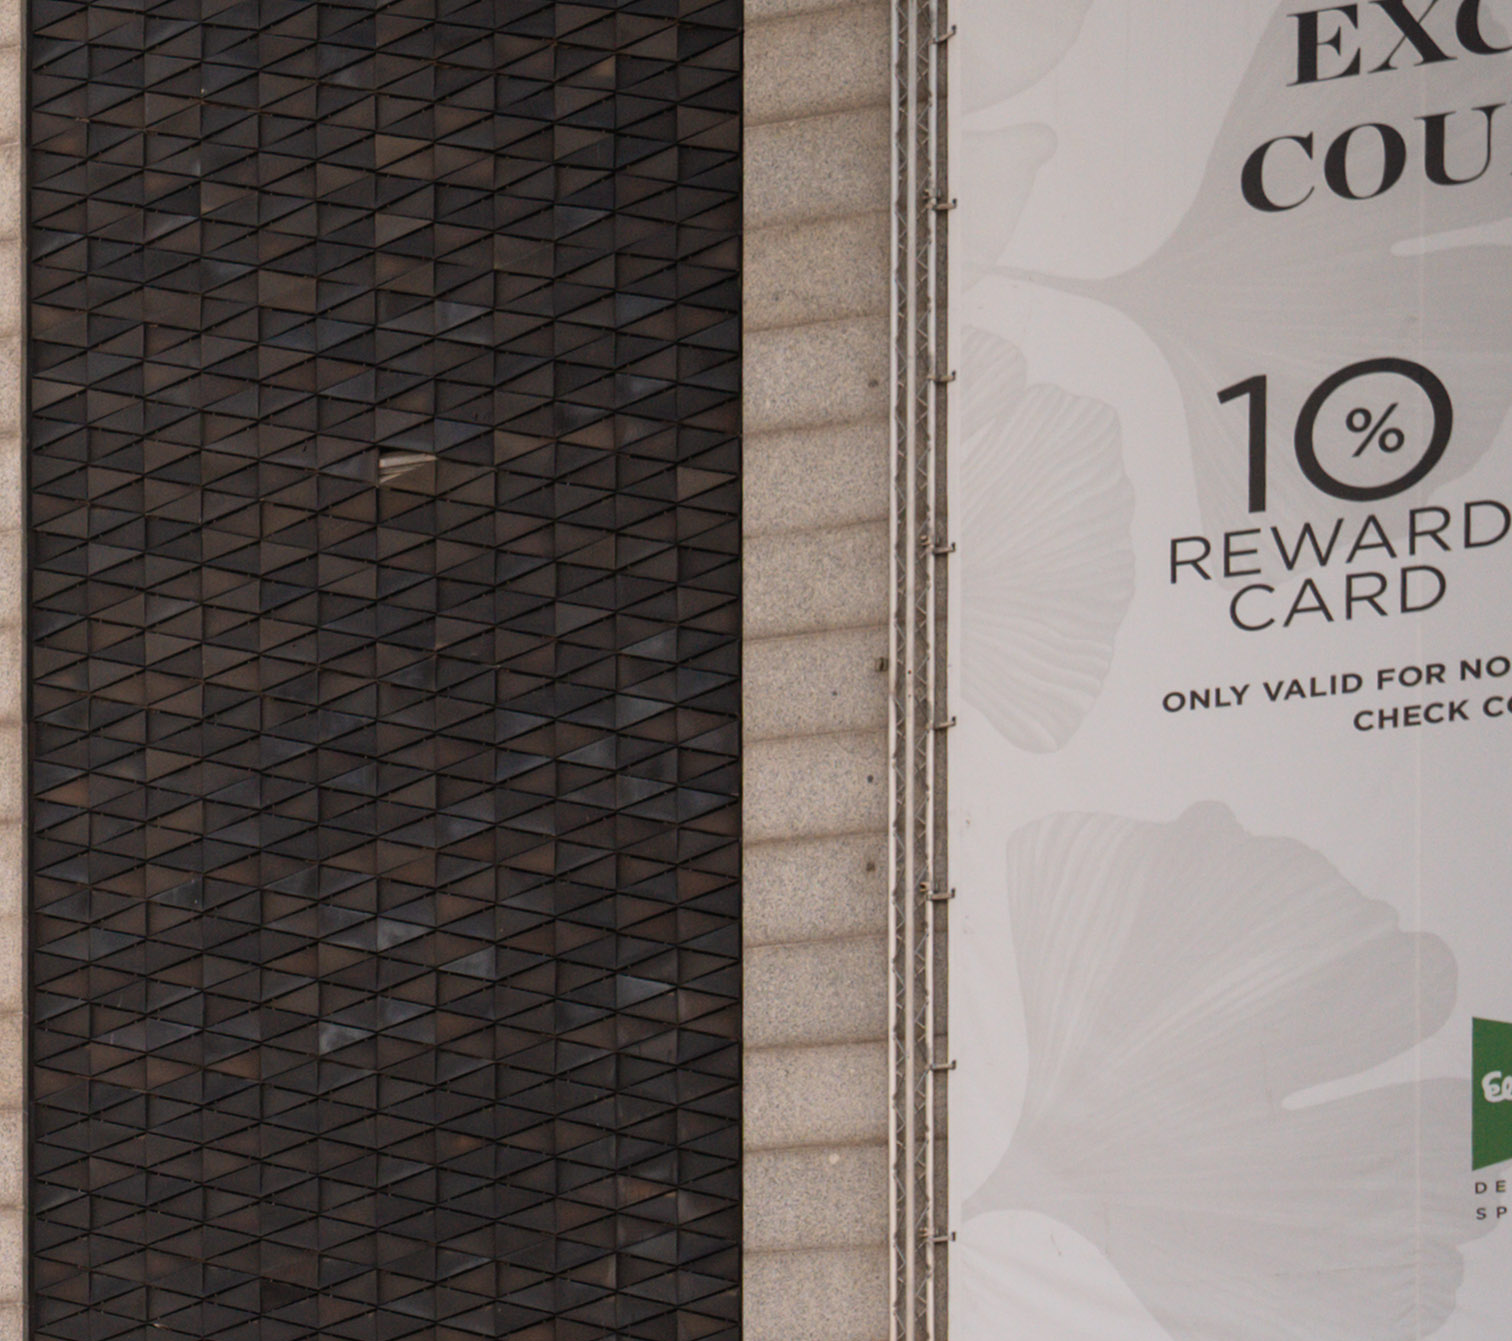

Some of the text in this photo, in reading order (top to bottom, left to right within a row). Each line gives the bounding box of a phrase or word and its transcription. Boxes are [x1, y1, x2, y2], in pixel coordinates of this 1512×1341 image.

[1170, 500, 1512, 584] REWARD
[1229, 565, 1447, 632] CARD
[1162, 683, 1250, 713] ONLY
[1263, 672, 1364, 701] VALID
[1376, 663, 1447, 690] FOR
[1353, 699, 1469, 731] CHECK
